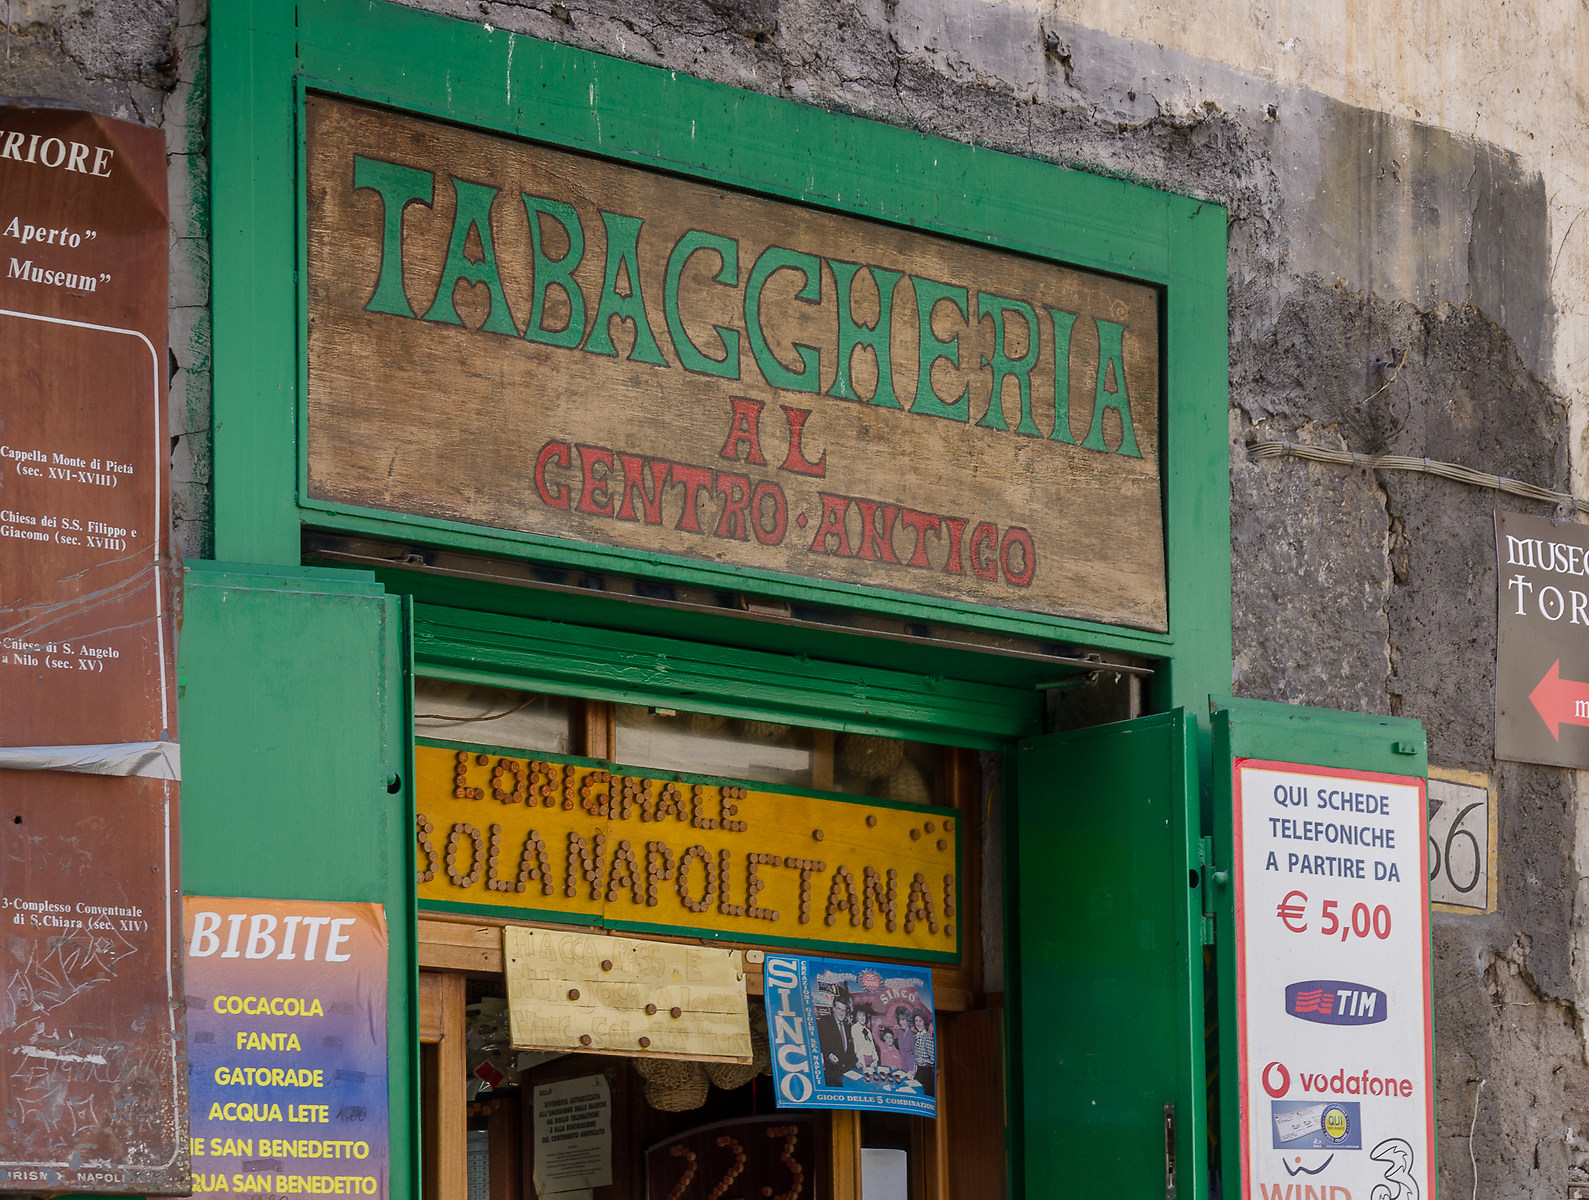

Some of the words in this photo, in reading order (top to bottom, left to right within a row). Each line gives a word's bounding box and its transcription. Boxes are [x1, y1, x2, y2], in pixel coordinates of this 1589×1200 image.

[353, 152, 1142, 458] TABACCHERIA
[720, 395, 826, 477] AL
[1, 446, 47, 463] Cappella
[52, 453, 86, 467] Monte
[90, 458, 101, 470] di
[16, 462, 43, 477] (sec.
[48, 467, 118, 488] XVI-XVIII)
[1, 510, 37, 525] Chiesa
[41, 515, 57, 528] dei
[87, 521, 127, 538] Filippo
[131, 528, 137, 537] e
[1, 525, 50, 541] Giacomo
[54, 531, 81, 546] (sec.
[86, 537, 127, 552] XVIII)
[46, 641, 58, 653] di
[62, 643, 75, 655] S.
[80, 645, 120, 660] Angelo
[2, 655, 8, 663] a
[13, 653, 39, 666] Nilo
[45, 655, 73, 669] (sec.
[79, 659, 104, 673] XV)
[1273, 784, 1308, 808] QUI
[1317, 788, 1390, 816] SCHEDE
[1268, 817, 1396, 849] TELEFONICHE
[1265, 851, 1279, 872] A
[1288, 852, 1366, 880] PARTIRE
[1374, 861, 1401, 883] DA
[76, 902, 143, 917] Conventuale
[1321, 899, 1392, 943] 5,00
[13, 913, 25, 925] di
[120, 919, 148, 933] XIV)
[189, 911, 356, 962] BIBITE
[213, 996, 324, 1017] COCACOLA
[1337, 989, 1377, 1017] TIM
[237, 1032, 301, 1052] FANTA
[214, 1067, 324, 1088] GATORADE
[1300, 1068, 1413, 1098] vodafone
[817, 1094, 845, 1102] GIOCO
[877, 1096, 883, 1104] 5
[208, 1103, 283, 1124] ACQUA
[288, 1104, 329, 1123] LETE
[1328, 1115, 1344, 1126] QUI
[210, 1138, 252, 1157] SAN
[259, 1139, 369, 1160] BENEDETTO
[232, 1175, 271, 1194] SAN
[276, 1175, 377, 1196] BENEDETTO
